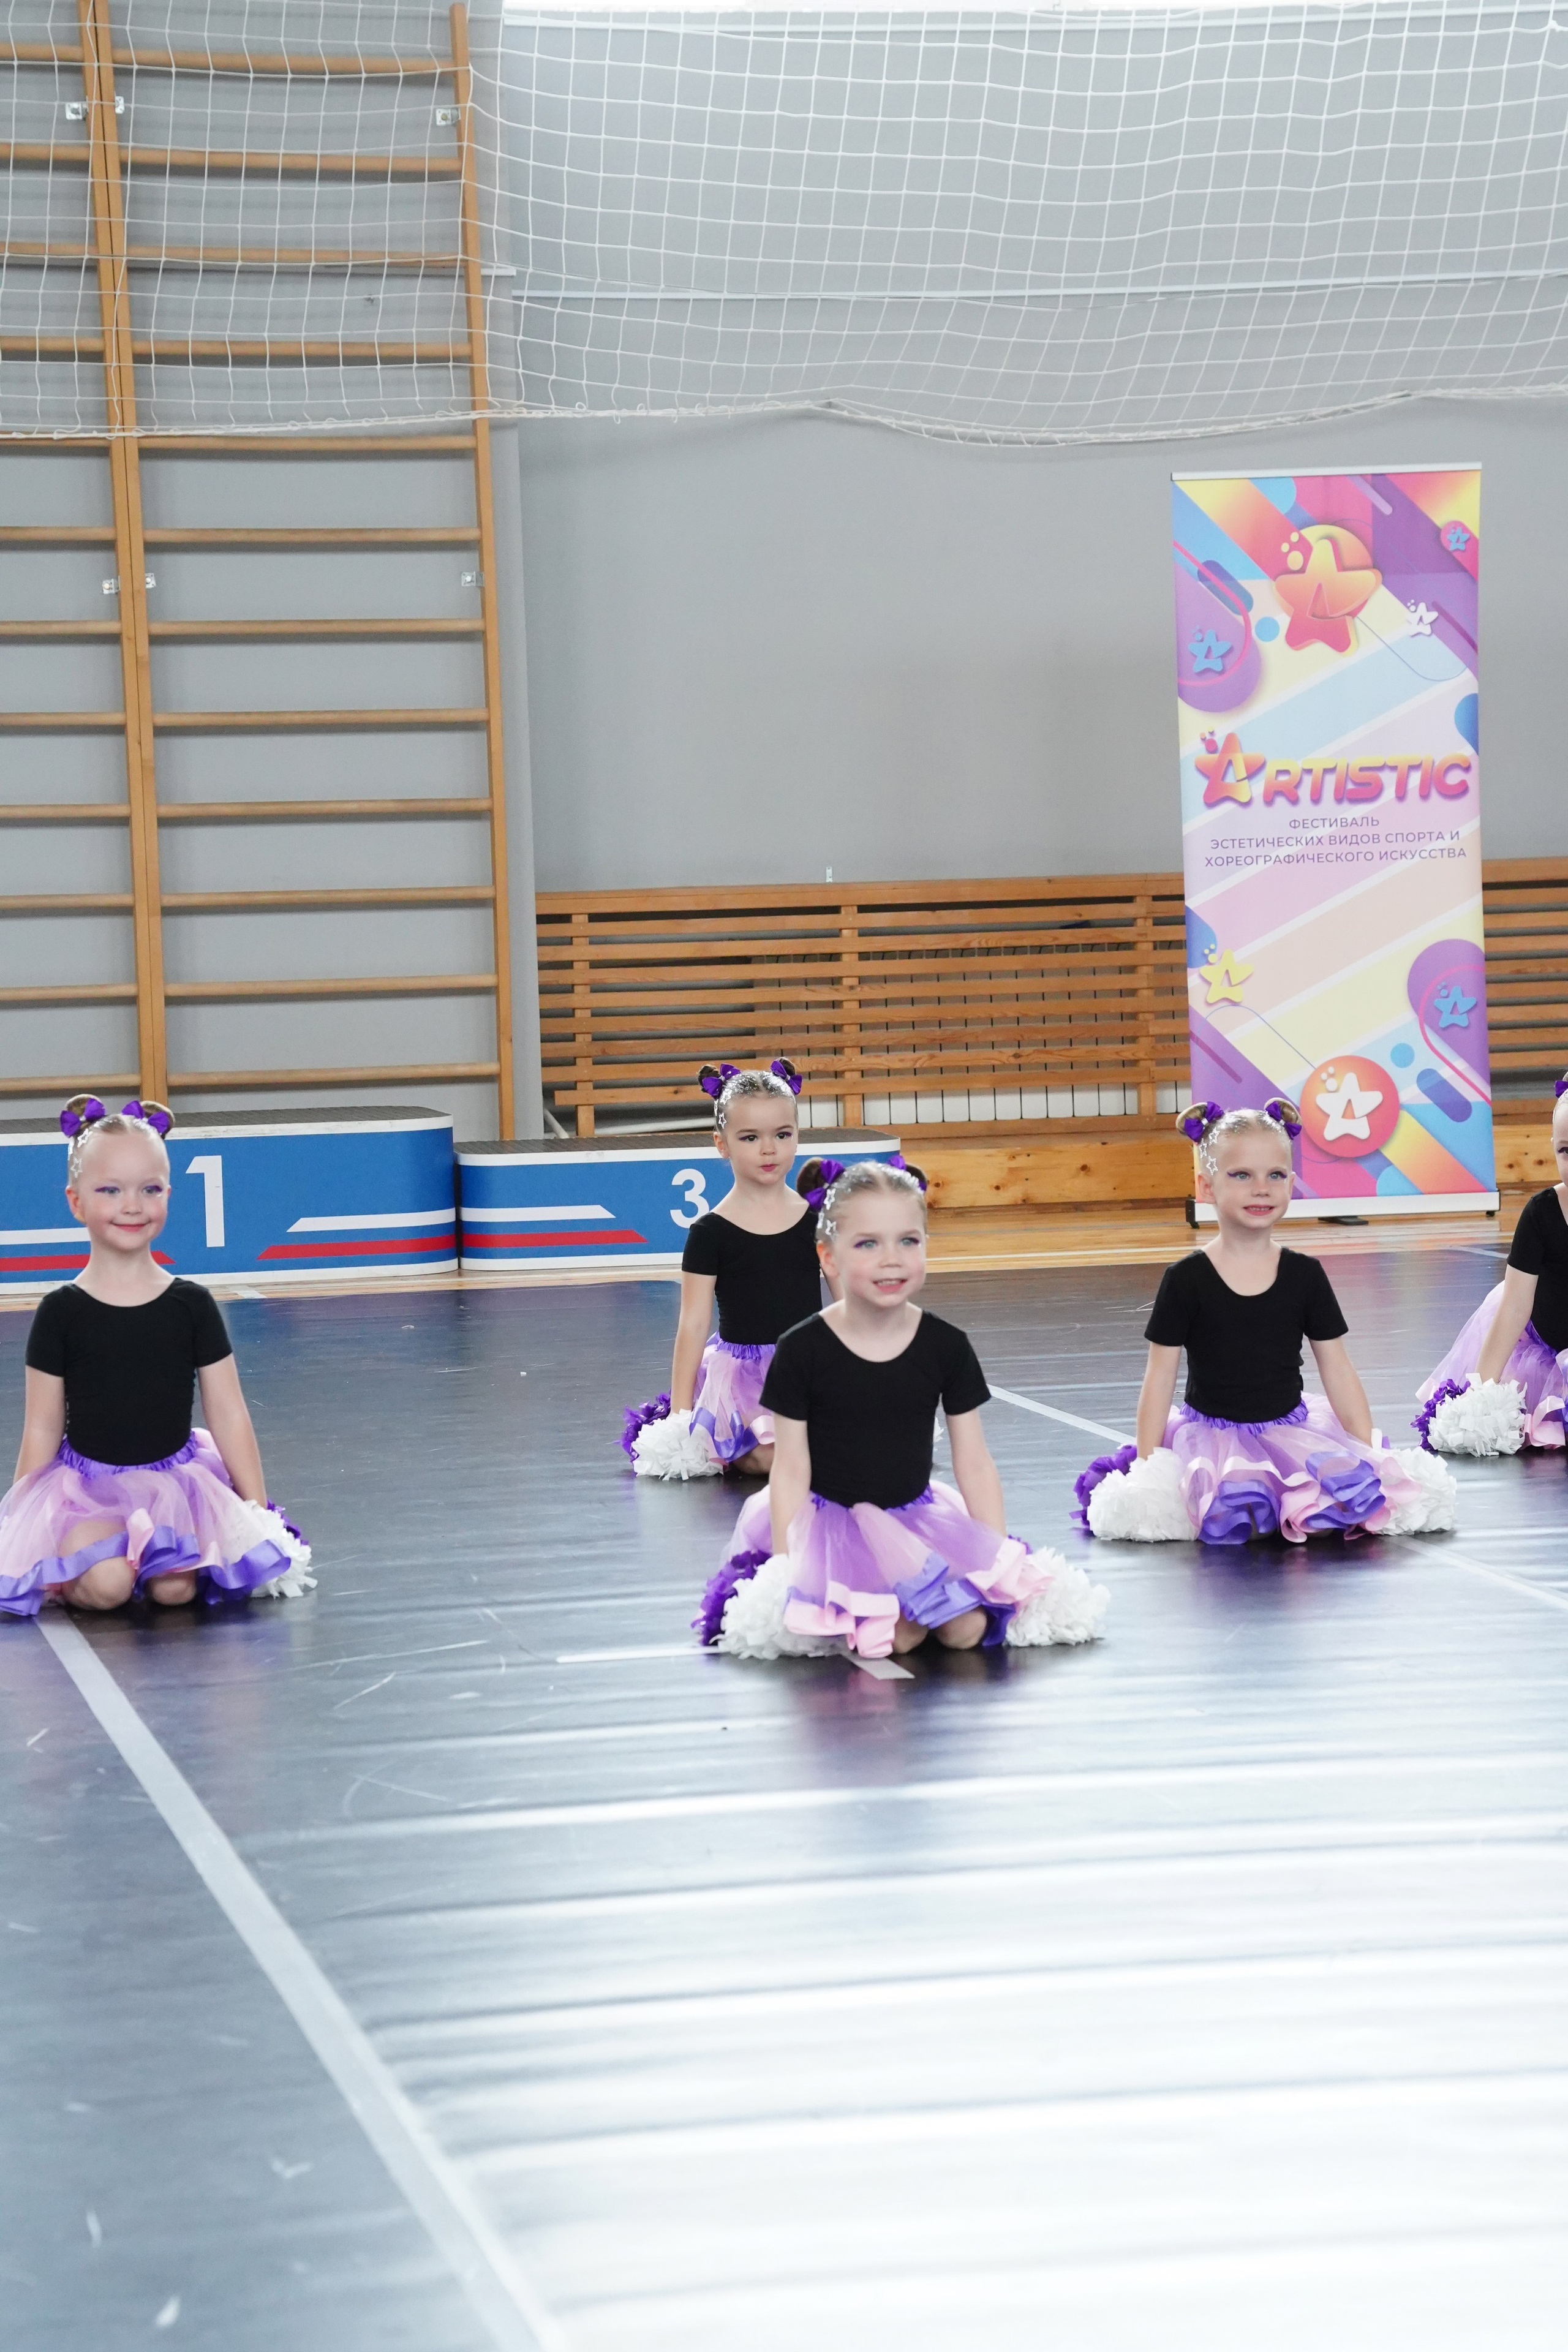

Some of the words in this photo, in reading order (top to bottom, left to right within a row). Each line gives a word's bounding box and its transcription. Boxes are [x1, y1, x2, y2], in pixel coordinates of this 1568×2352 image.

[1289, 816, 1379, 829] ФЕСТИВАЛЬ
[1210, 835, 1324, 850] ЭСТЕТИЧЕСКИХ
[1329, 834, 1381, 846] ВИДОВ
[1385, 831, 1446, 843] СПОРТА
[1450, 831, 1460, 841] И
[1205, 851, 1374, 867] ХОРЕОГРАФИЧЕСКОГО
[1379, 848, 1467, 861] ИСКУССТВА
[186, 1155, 225, 1247] 1
[670, 1168, 709, 1229] 3
